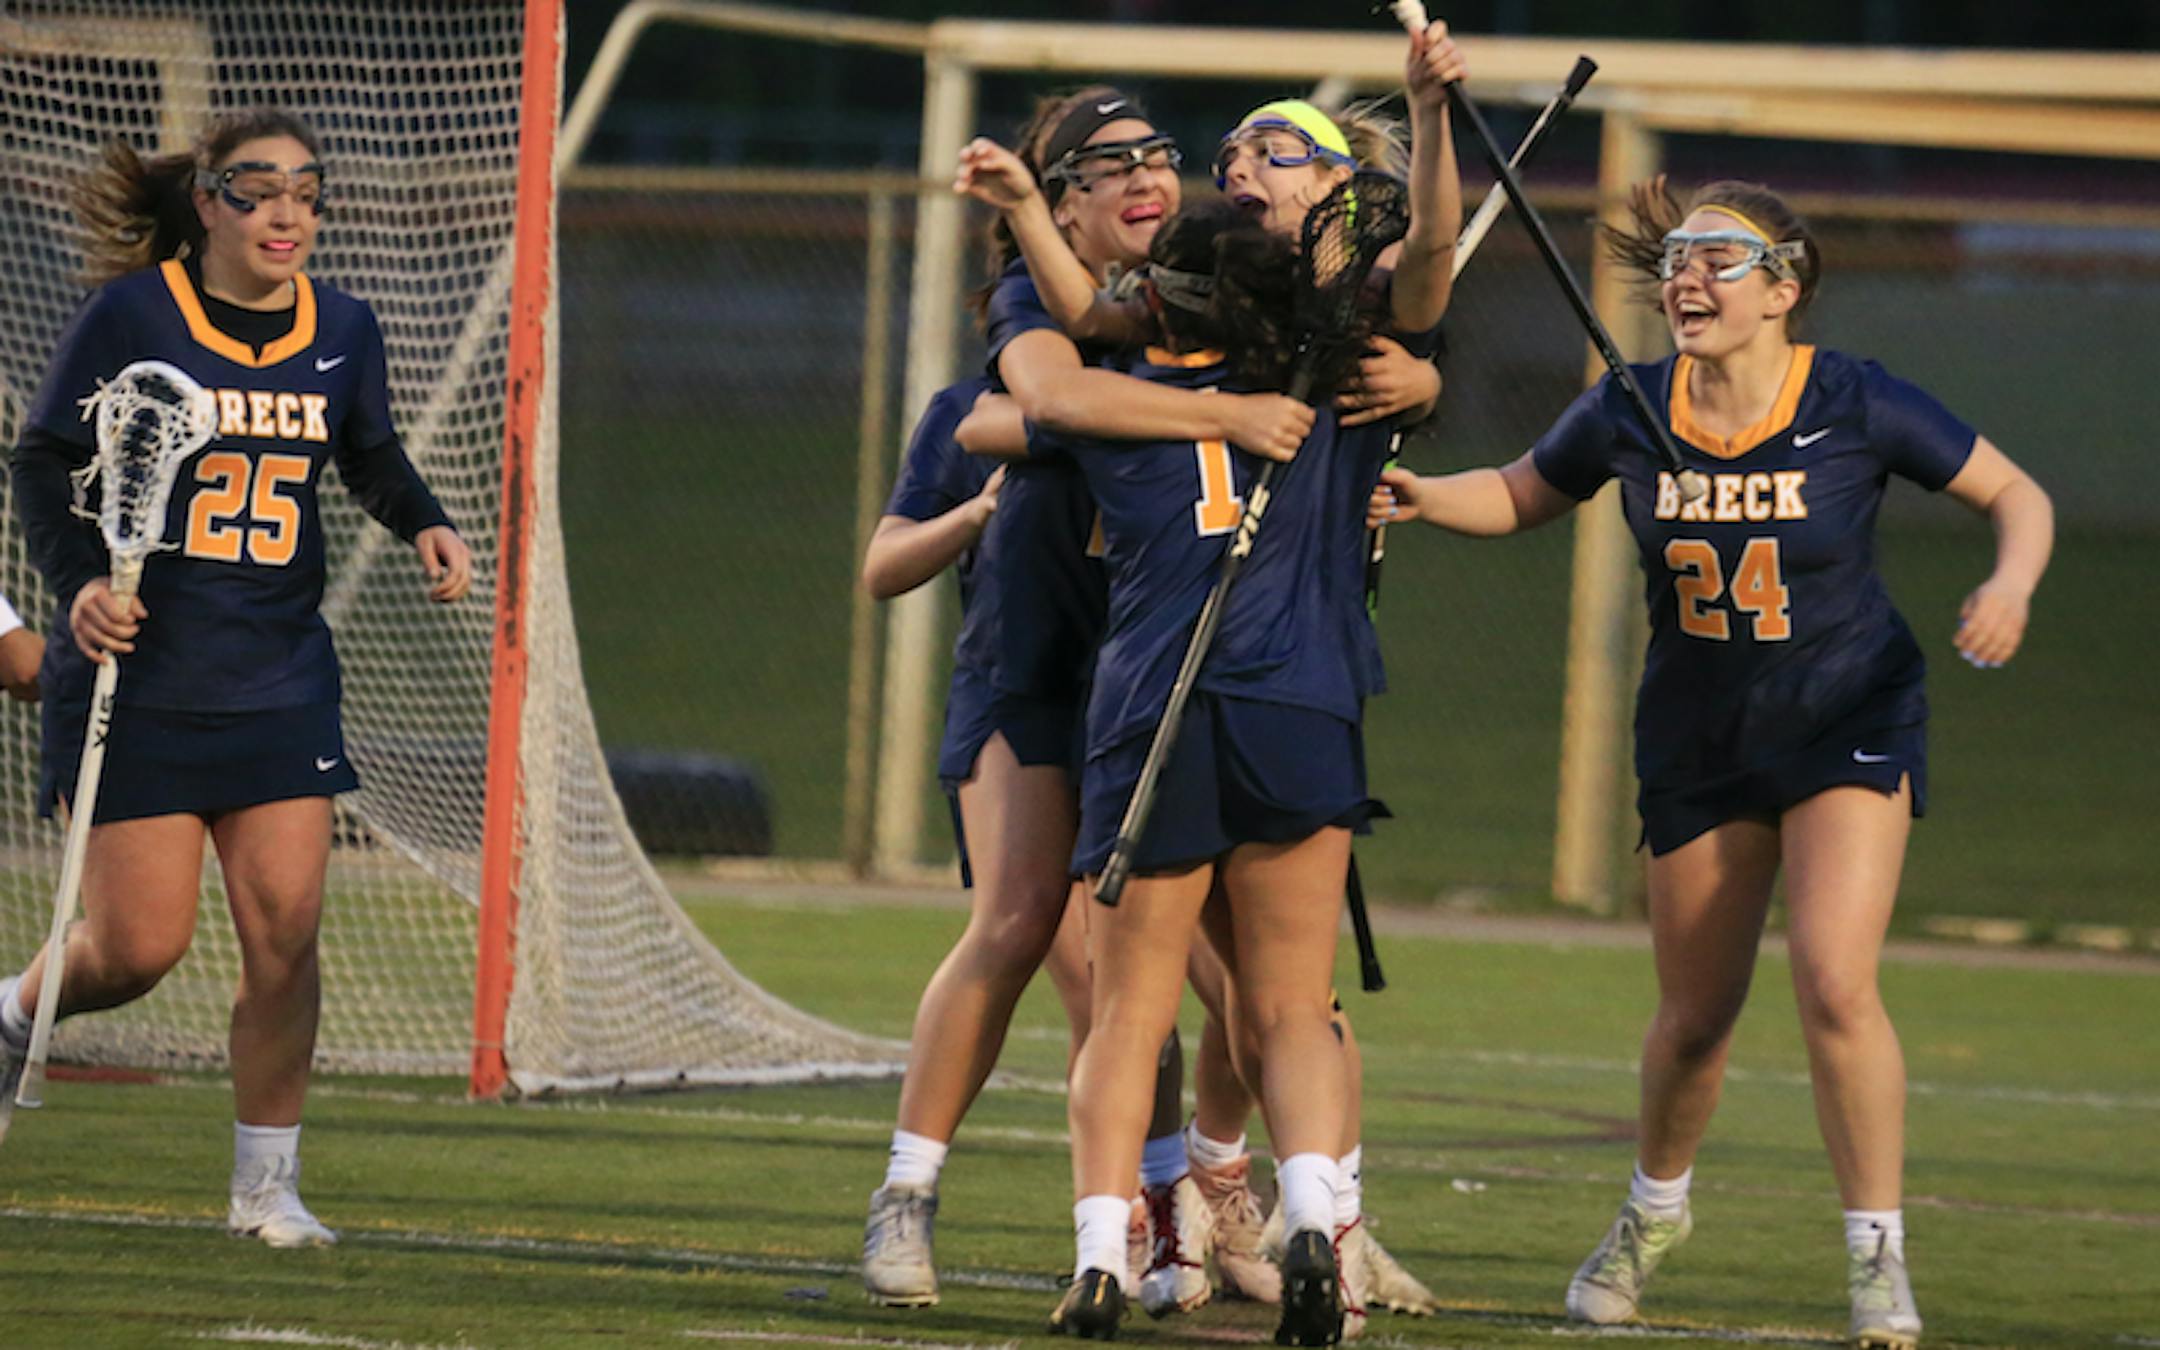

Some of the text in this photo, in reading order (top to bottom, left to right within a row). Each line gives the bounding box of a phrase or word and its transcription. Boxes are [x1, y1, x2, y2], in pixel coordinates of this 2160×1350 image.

[200, 386, 329, 443] RECK
[1194, 385, 1243, 537] 1
[183, 452, 312, 566] 25
[1654, 470, 1808, 521] BRECK
[1664, 536, 1792, 641] 24
